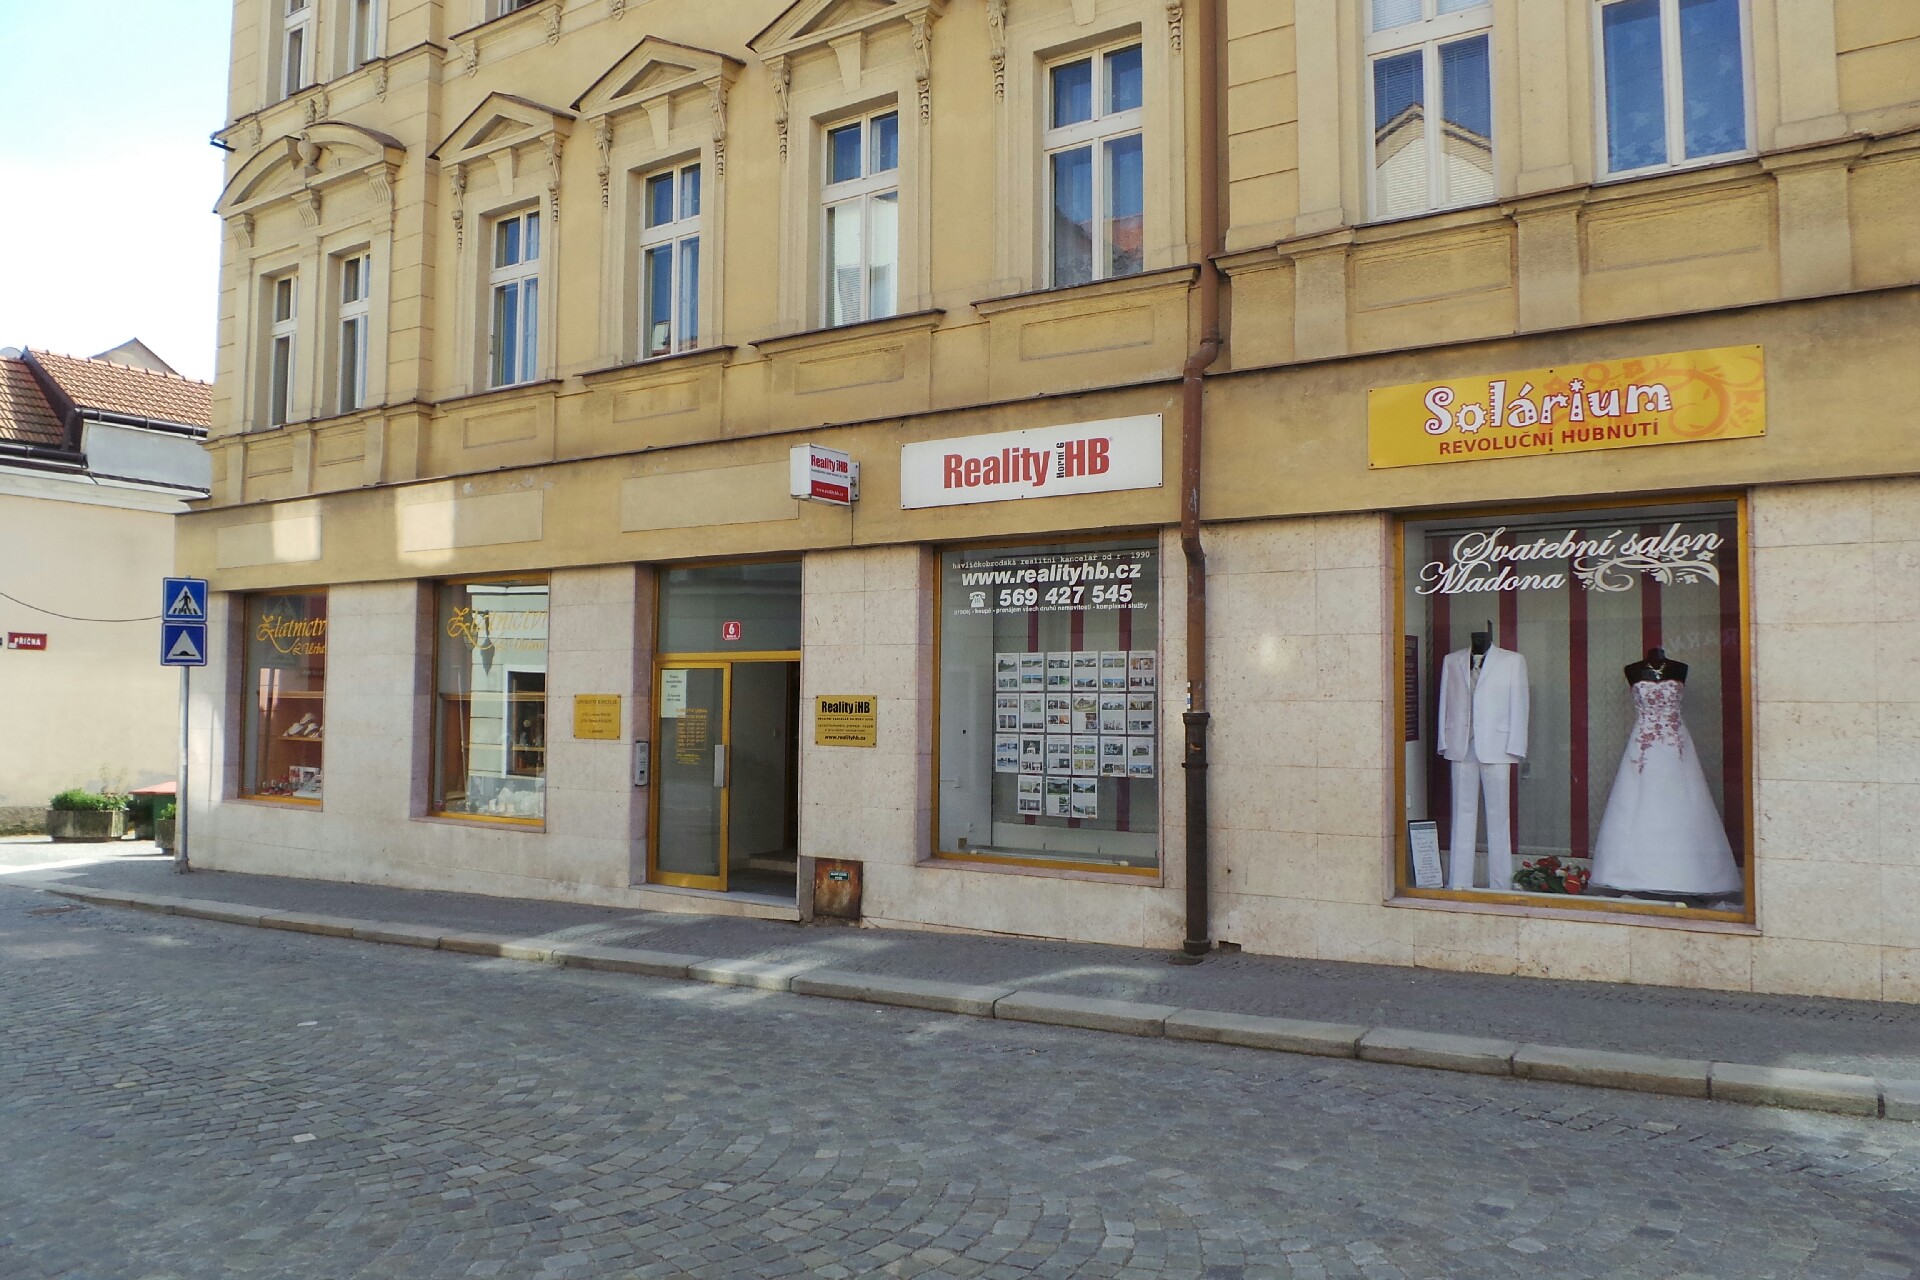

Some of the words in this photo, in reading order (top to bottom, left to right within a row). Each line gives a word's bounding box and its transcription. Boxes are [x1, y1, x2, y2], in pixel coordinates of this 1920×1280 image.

[1423, 377, 1673, 435] Solárium
[1438, 428, 1554, 456] REVOLUČNÍ
[1561, 417, 1660, 445] HUBNUTÍ
[810, 454, 836, 473] Reality
[943, 446, 1051, 489] Reality
[1056, 451, 1065, 479] Horní
[1101, 552, 1112, 561] od
[1130, 550, 1151, 560] 1990
[1452, 526, 1624, 571] Svatební
[1619, 522, 1725, 555] salon
[961, 561, 1142, 586] www.realityhb.cz
[1414, 561, 1567, 595] Madona
[999, 588, 1038, 607] 569
[1044, 586, 1085, 605] 427
[1091, 584, 1133, 604] 545
[728, 623, 735, 635] 6
[821, 700, 854, 715] Reality
